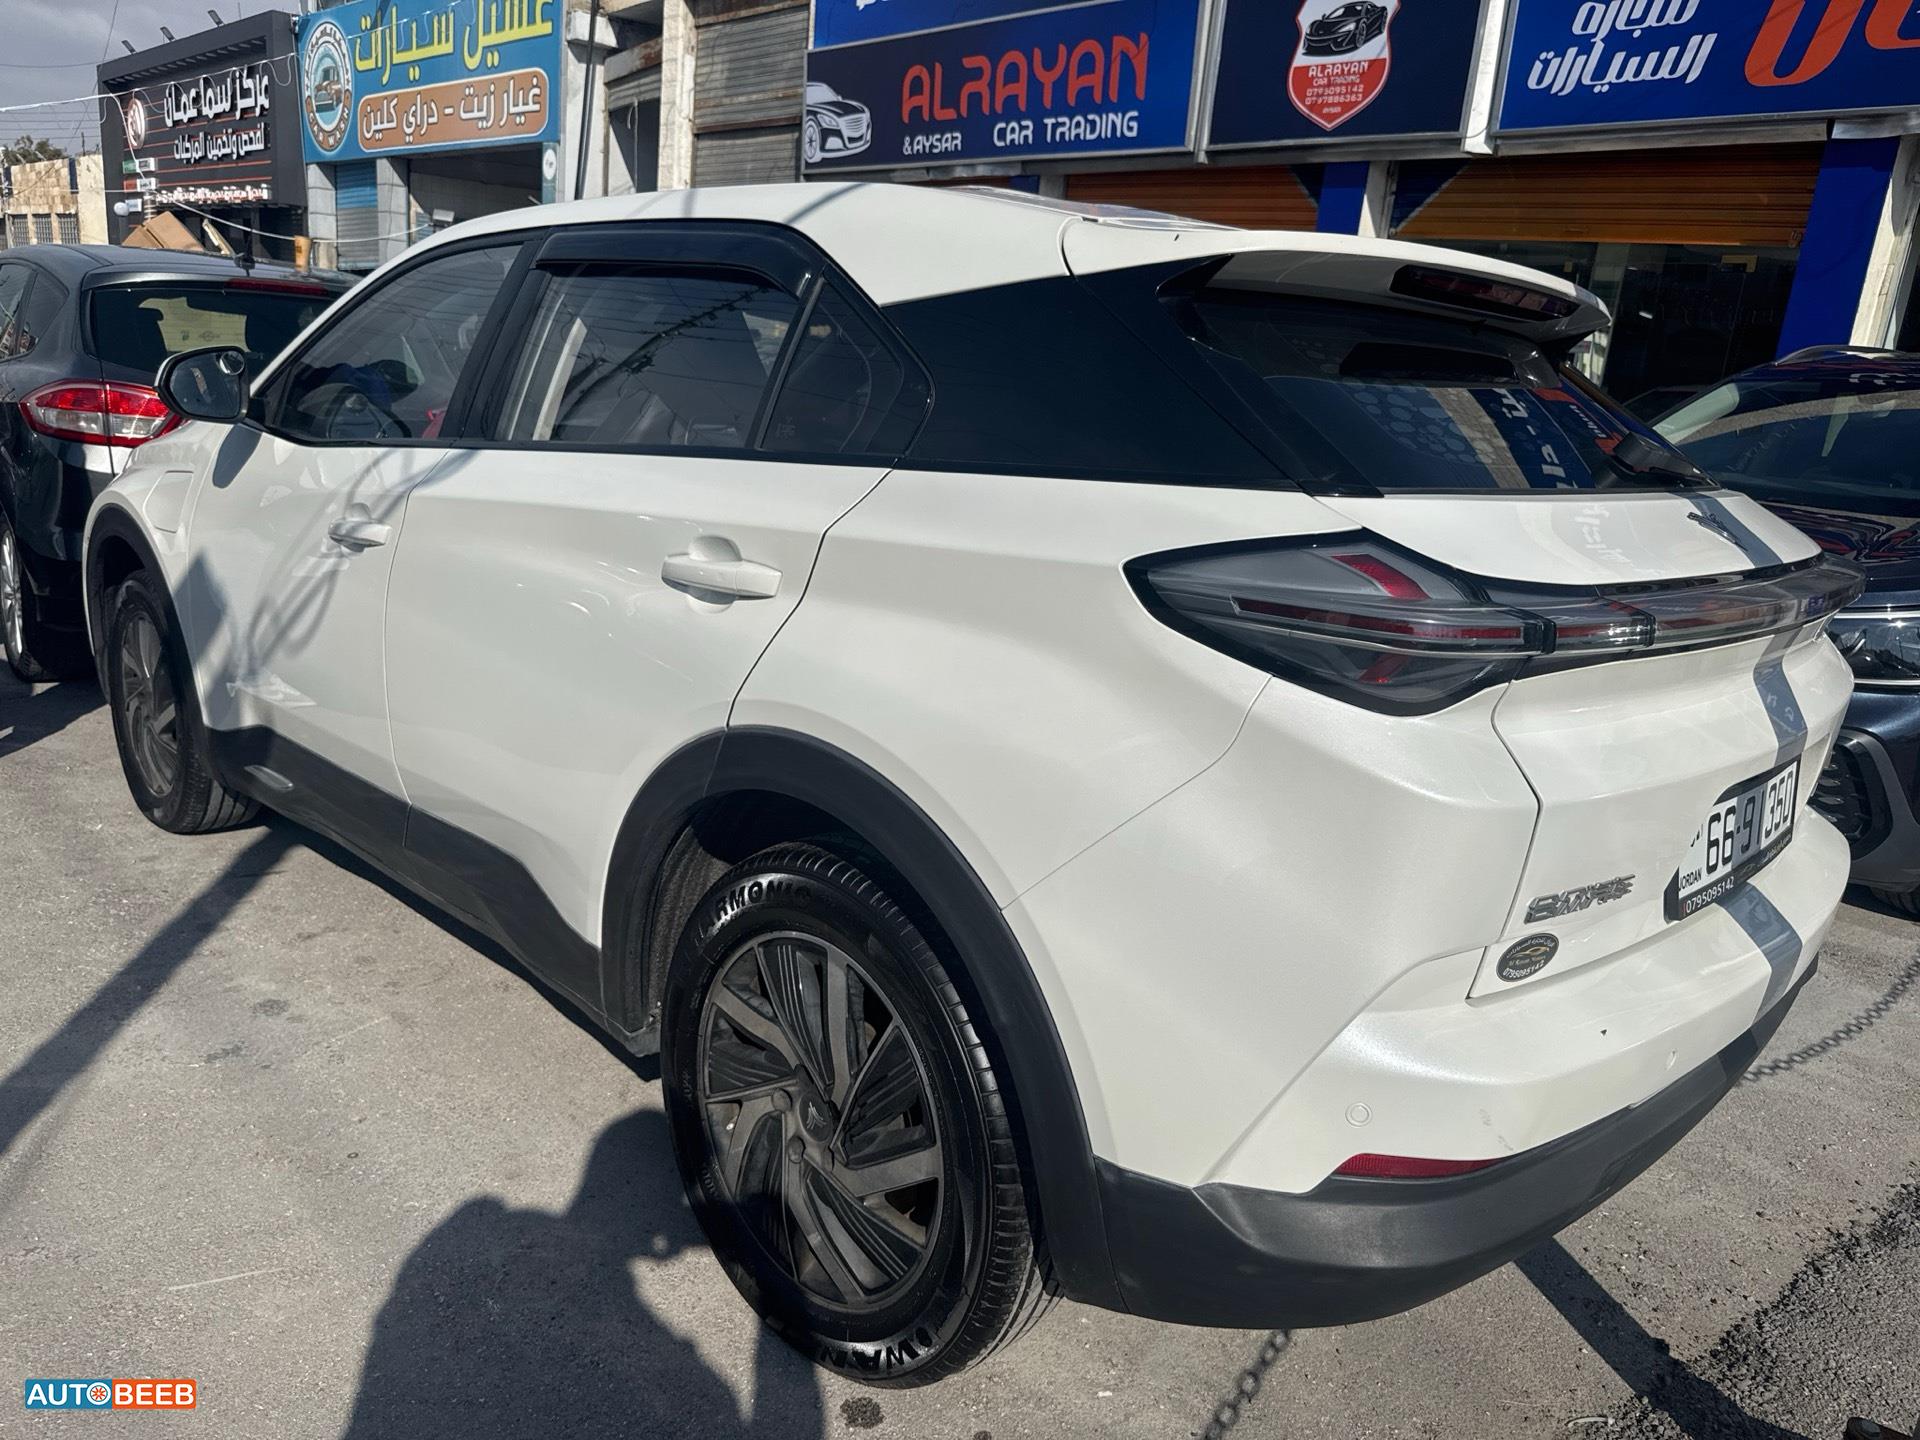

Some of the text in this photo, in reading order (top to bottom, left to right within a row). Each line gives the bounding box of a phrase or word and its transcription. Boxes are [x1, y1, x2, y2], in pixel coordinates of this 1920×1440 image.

[355, 5, 454, 85] سيارات
[1527, 33, 1717, 96] السيارات
[902, 32, 1149, 123] ALRAYAN
[1309, 62, 1369, 78] ALRAYAN
[1313, 78, 1328, 86] CAR
[164, 65, 270, 127] مركز سما عمان
[363, 97, 398, 140] كلين
[403, 94, 438, 143] دراي
[459, 82, 496, 128] زيت
[499, 76, 541, 127] غيار
[174, 122, 265, 164] لفحص وتخمين المركبات
[993, 111, 1139, 147] CAR TRADING
[1685, 876, 1735, 913] 0795095142
